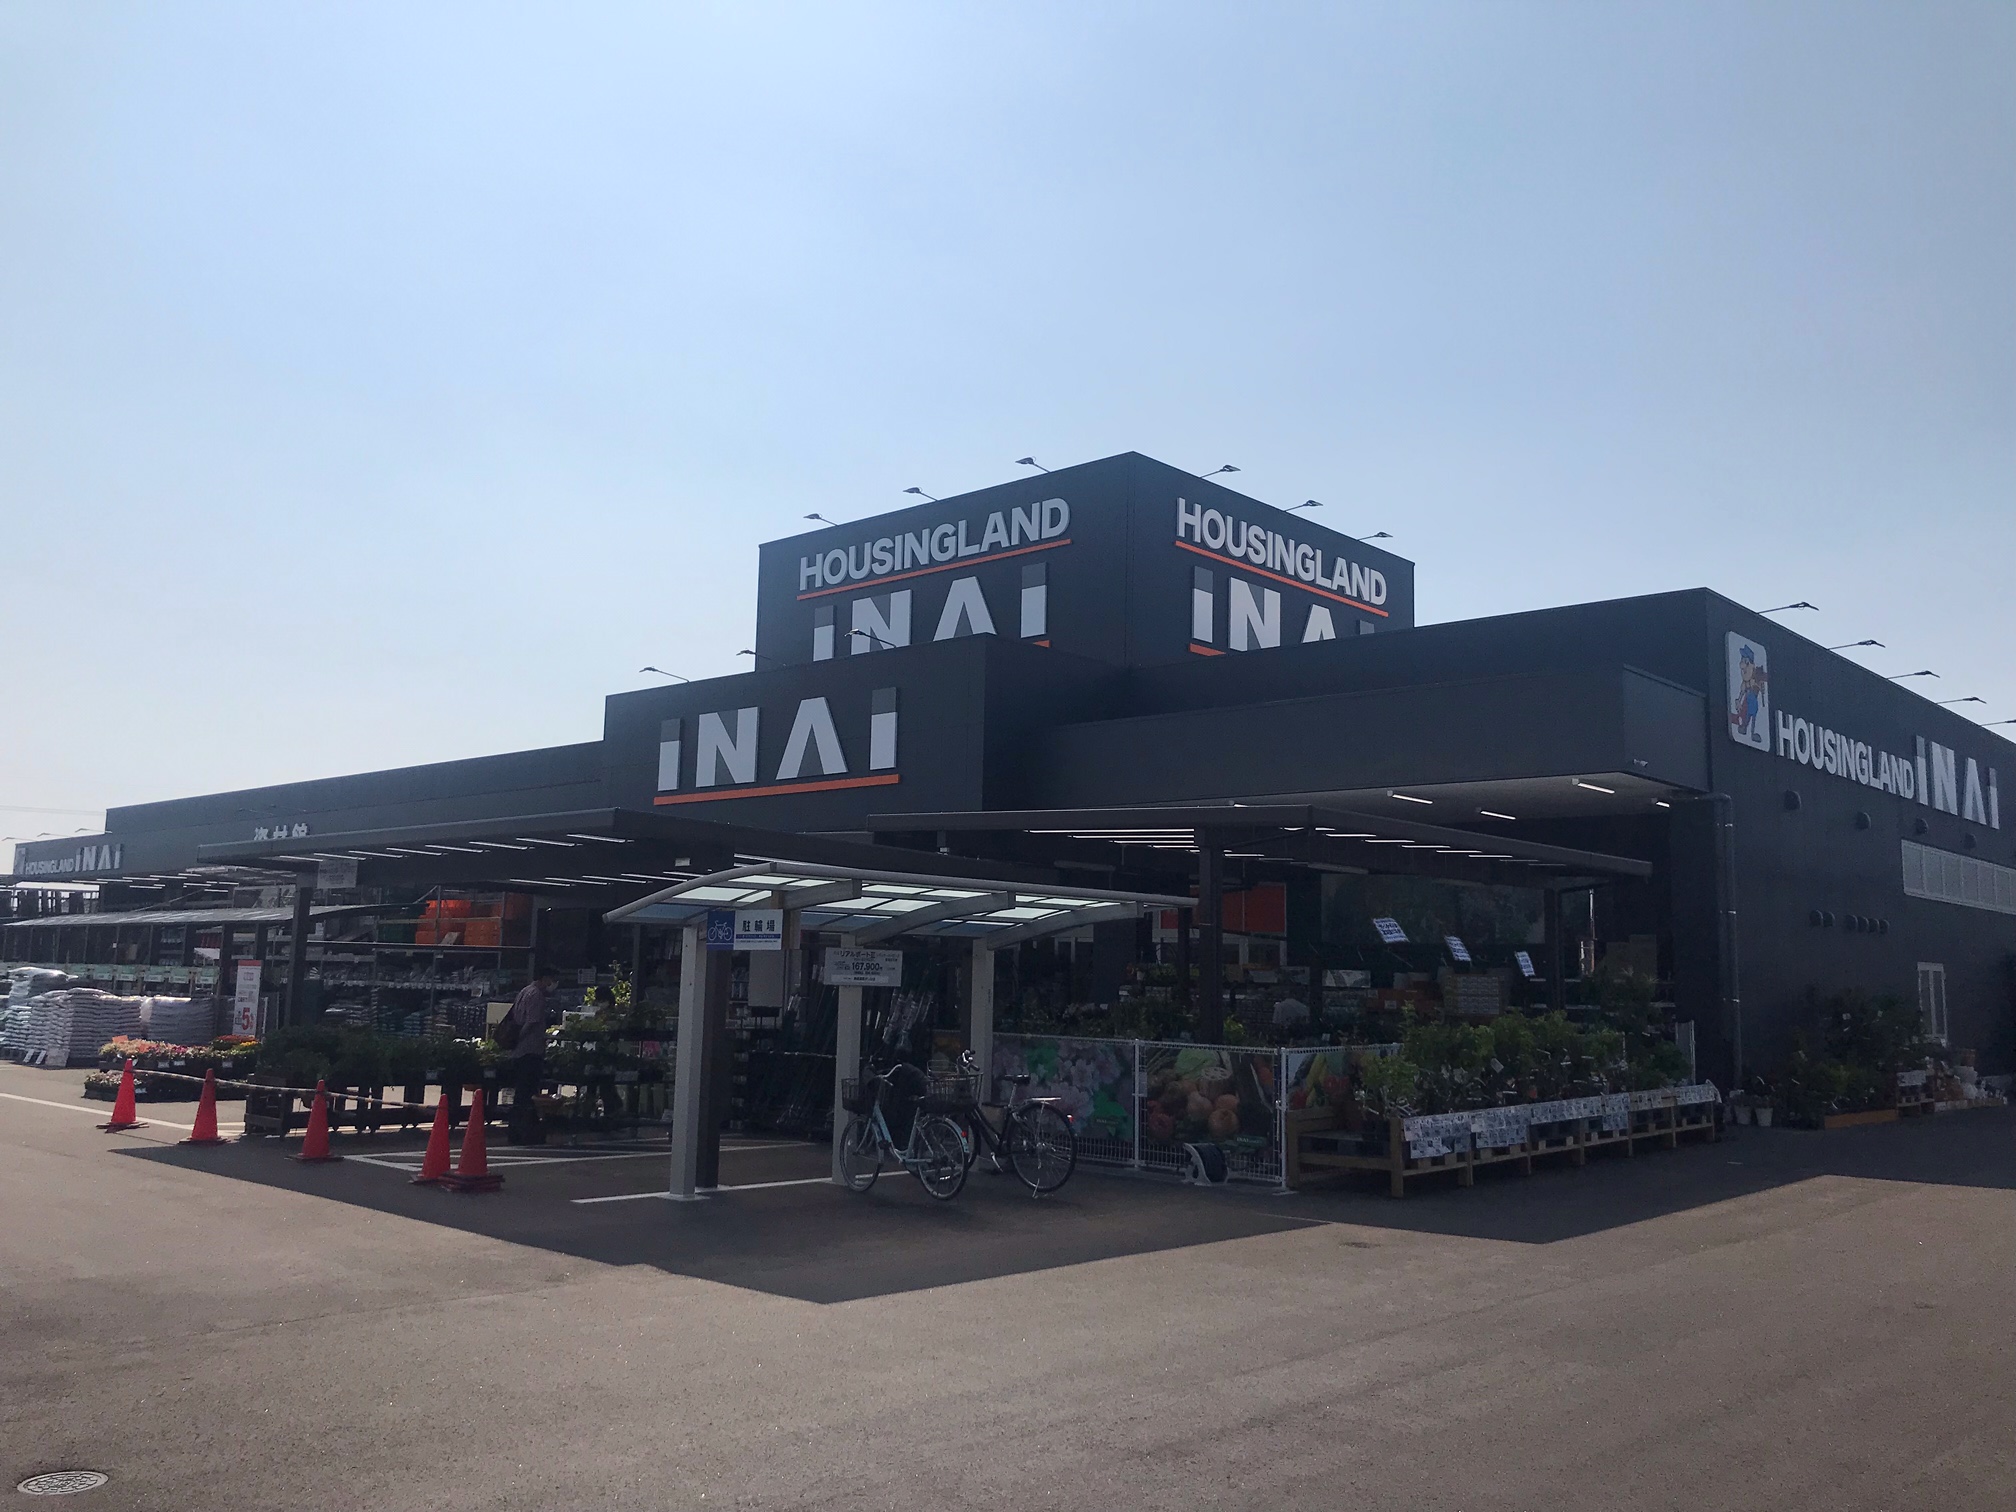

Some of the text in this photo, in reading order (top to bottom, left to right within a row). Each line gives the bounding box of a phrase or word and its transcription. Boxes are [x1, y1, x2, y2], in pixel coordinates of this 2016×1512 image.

[800, 497, 1069, 591] HOUSINGLAND
[1177, 497, 1387, 605] HOUSINGLAND
[1192, 566, 1375, 652] INA
[1776, 710, 1914, 799] HOUSINGLAND
[26, 858, 73, 875] HOUSINGLAND
[742, 919, 775, 932] 駐輪場
